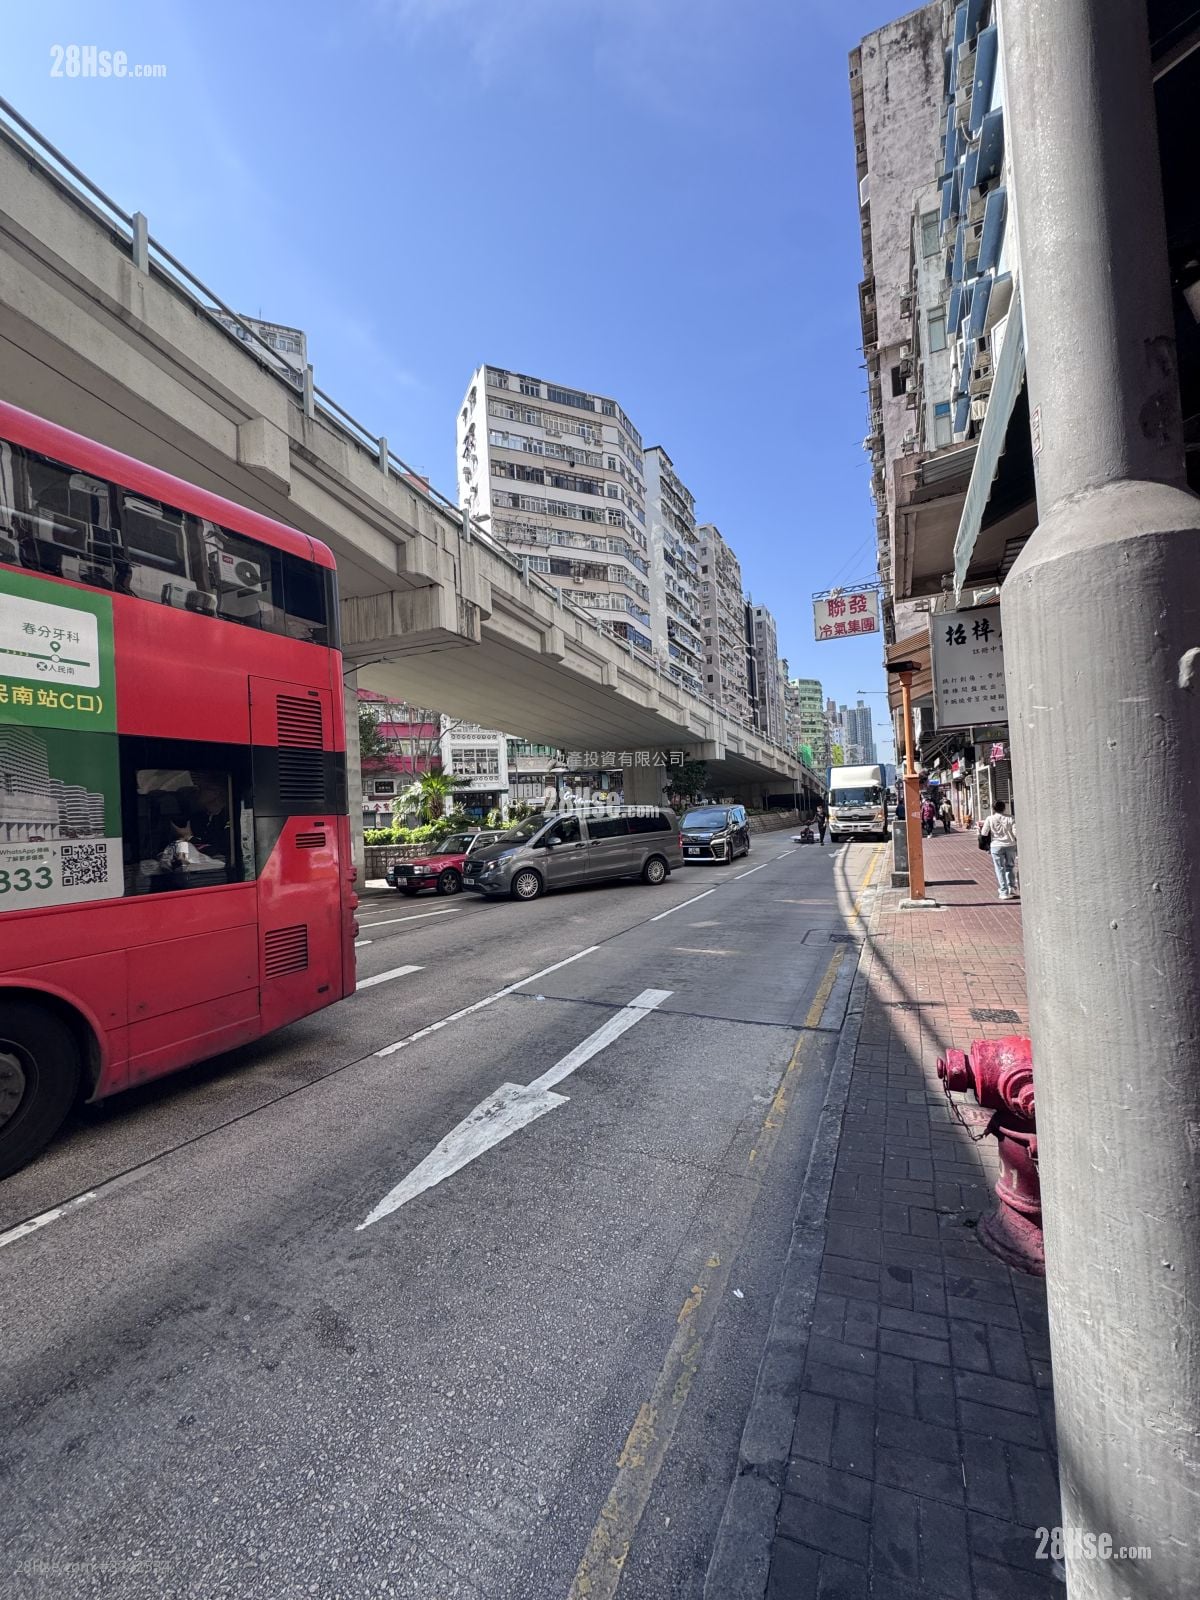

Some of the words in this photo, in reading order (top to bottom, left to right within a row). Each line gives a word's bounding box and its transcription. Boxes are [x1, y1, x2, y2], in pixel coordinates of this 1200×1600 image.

[827, 594, 867, 617] 聯發
[22, 622, 80, 643] 春分牙科
[819, 617, 875, 638] 冷氣集團
[945, 618, 1002, 646] 招梓
[48, 664, 75, 676] 人民南
